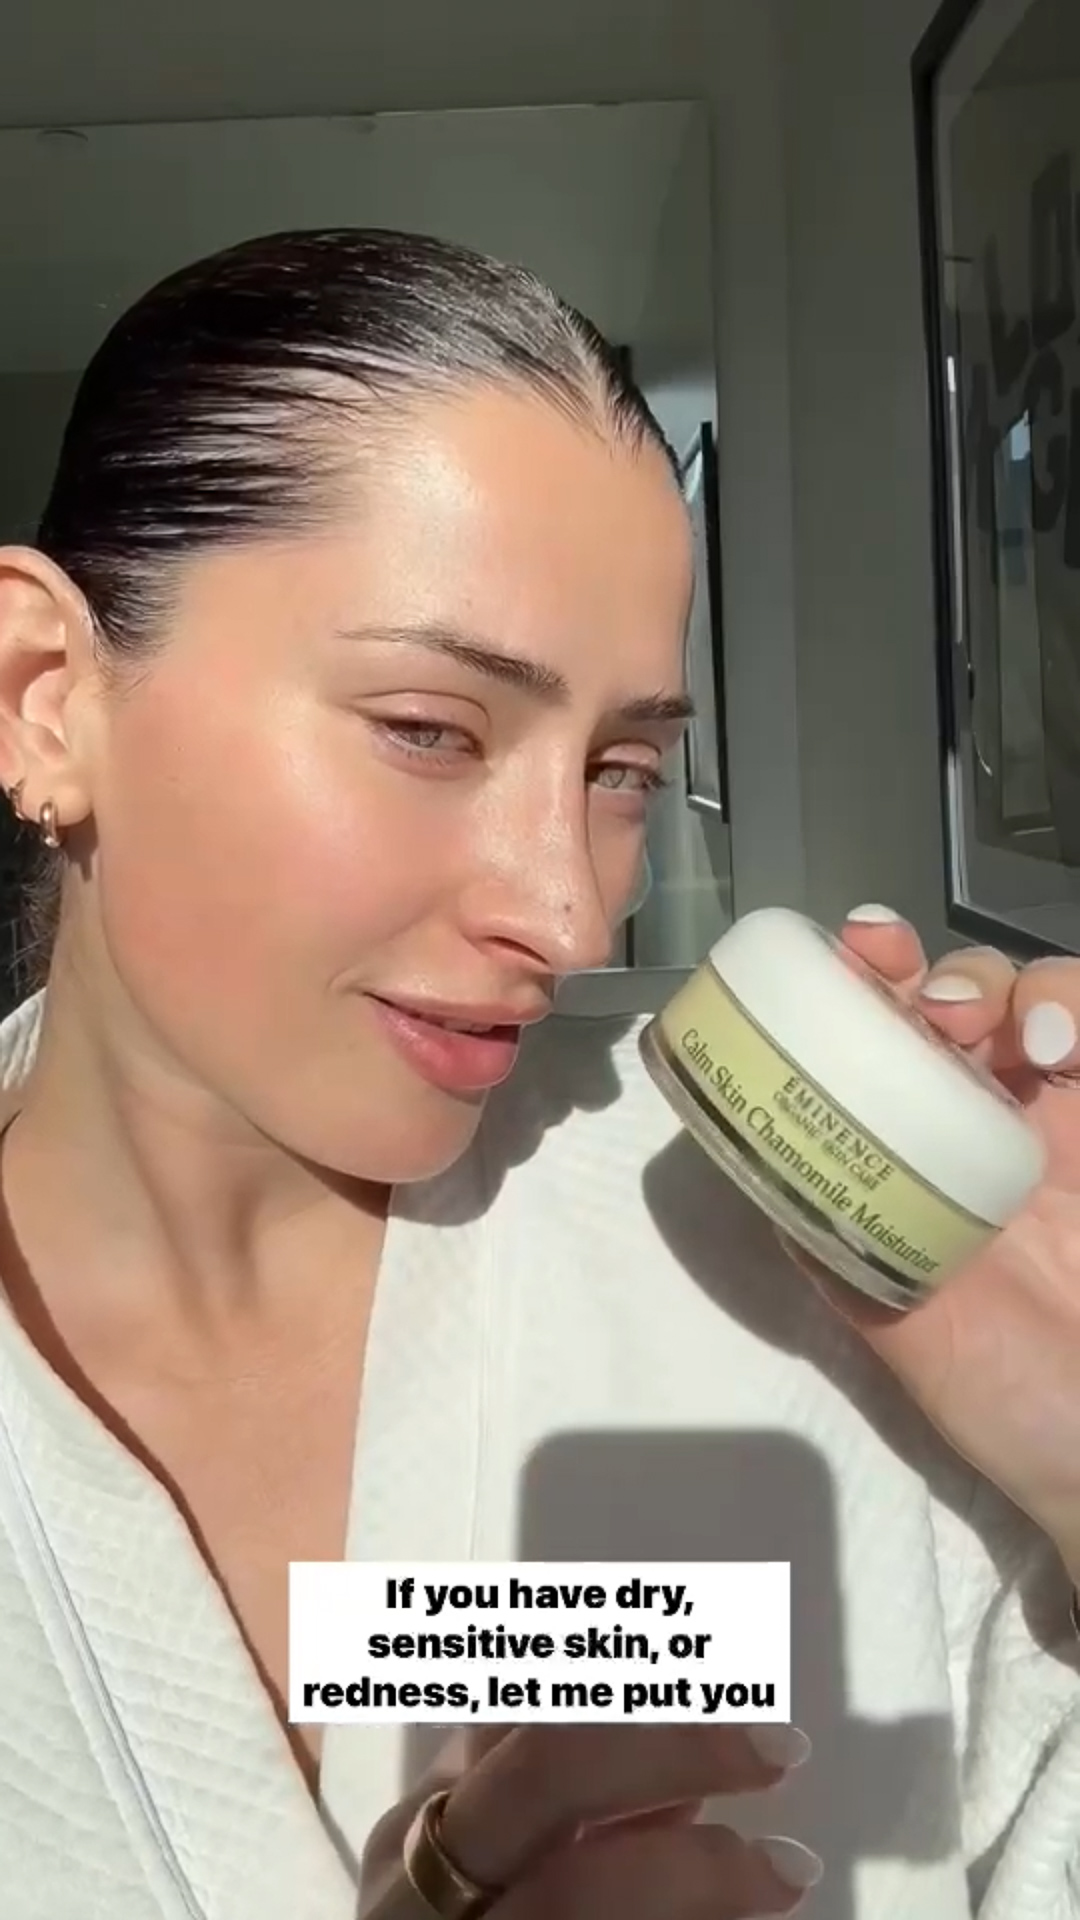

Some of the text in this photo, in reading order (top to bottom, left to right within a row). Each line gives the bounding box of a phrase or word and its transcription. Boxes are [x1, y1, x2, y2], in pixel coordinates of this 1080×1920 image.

[681, 1027, 716, 1075] Calm
[711, 1065, 748, 1114] Skin
[745, 1105, 855, 1212] Chamomile
